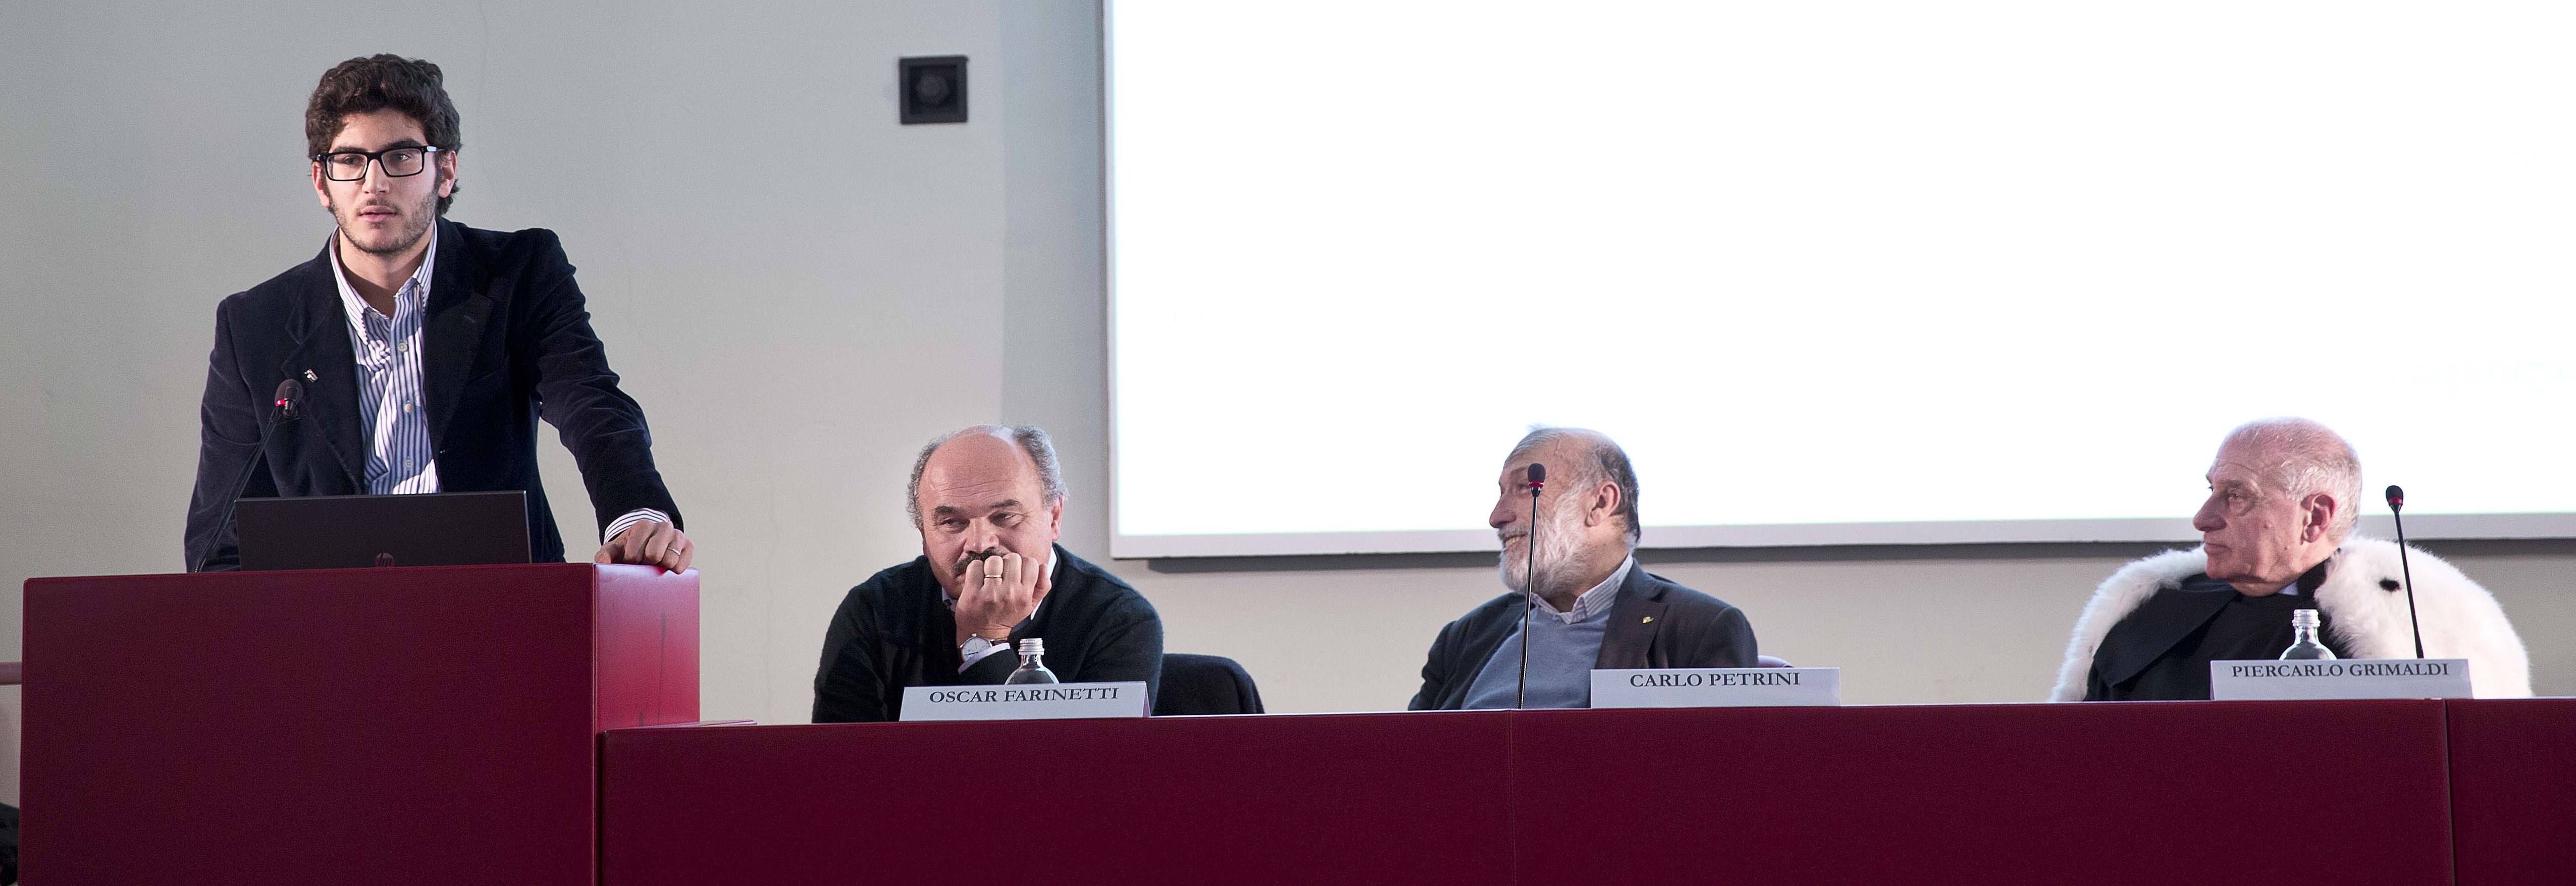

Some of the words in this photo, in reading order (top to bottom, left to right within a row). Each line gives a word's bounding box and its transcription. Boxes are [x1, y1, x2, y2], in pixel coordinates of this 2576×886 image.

[2233, 664, 2343, 677] PIERCARLO
[2349, 663, 2448, 676] GRIMALDI
[1631, 674, 1702, 687] CARLO
[1709, 673, 1800, 686] PETRINI
[929, 691, 997, 702] OSCAR
[1003, 688, 1119, 701] FARINETTI
